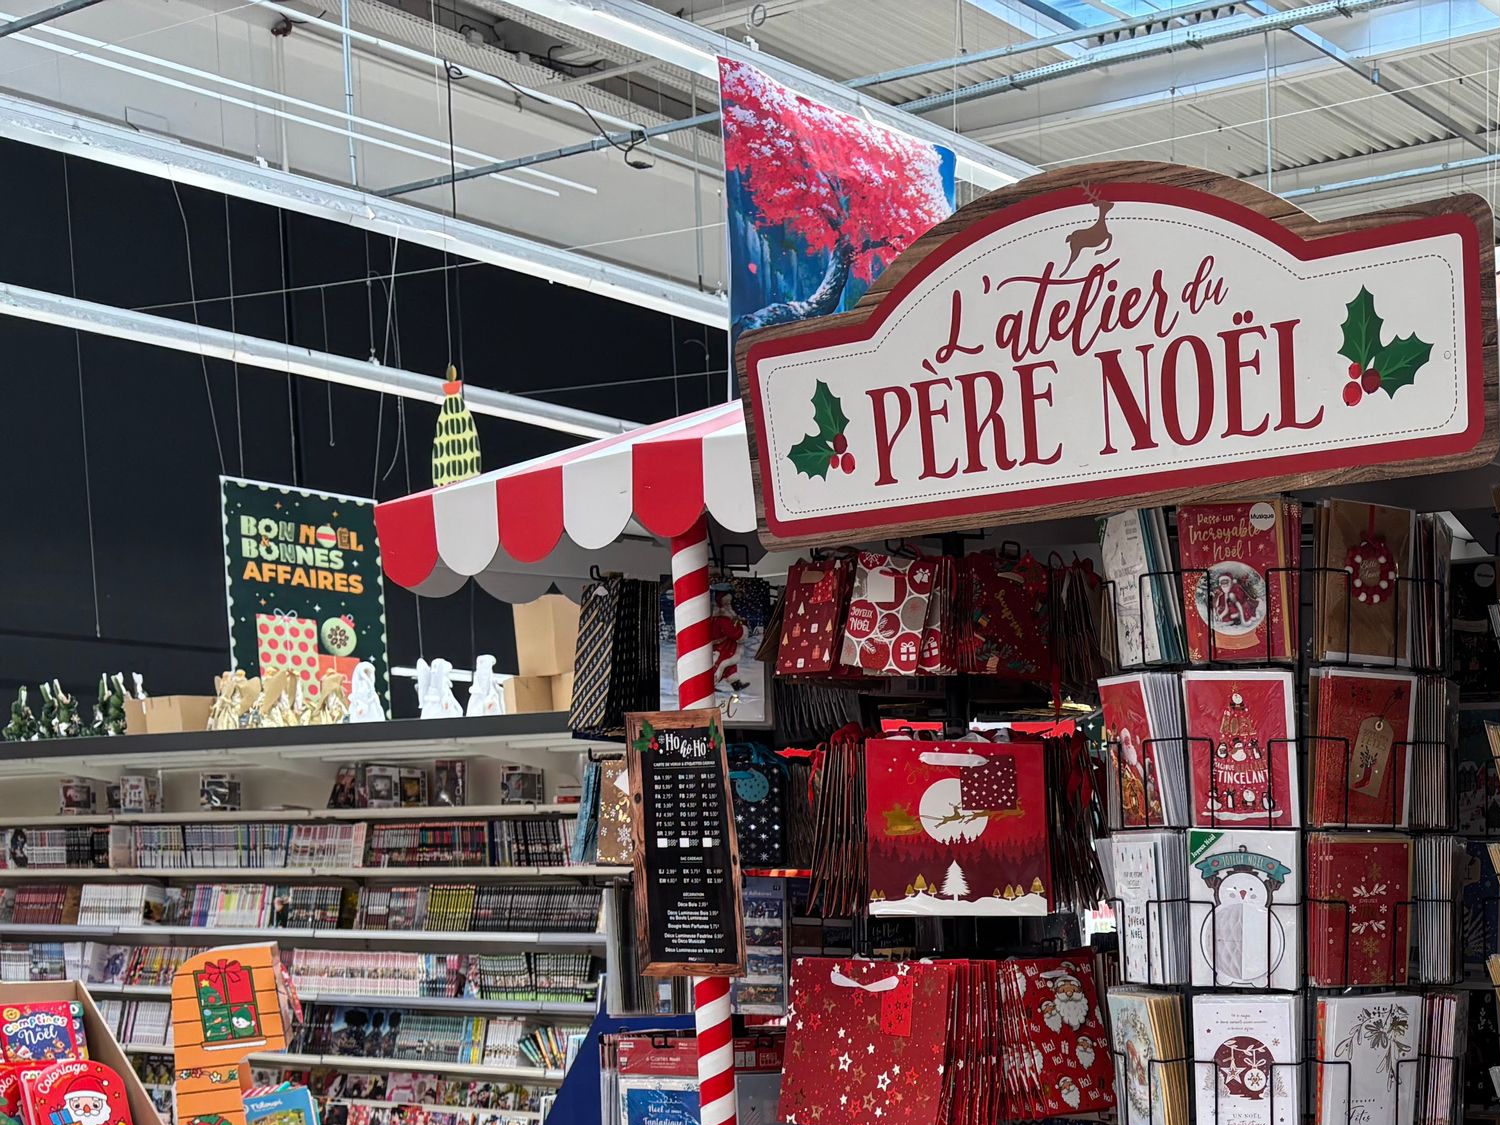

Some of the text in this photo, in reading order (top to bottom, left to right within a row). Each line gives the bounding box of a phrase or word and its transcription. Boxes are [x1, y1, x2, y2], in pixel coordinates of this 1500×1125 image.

[935, 255, 1228, 365] L'atelier du
[866, 311, 1325, 486] PÈRE NOËL
[240, 514, 295, 543] BON
[1189, 517, 1261, 544] Incroyable
[241, 537, 345, 570] BONNES
[242, 560, 364, 595] AFFAIRES
[18, 1024, 58, 1045] Noël
[37, 1062, 89, 1094] Coloriage
